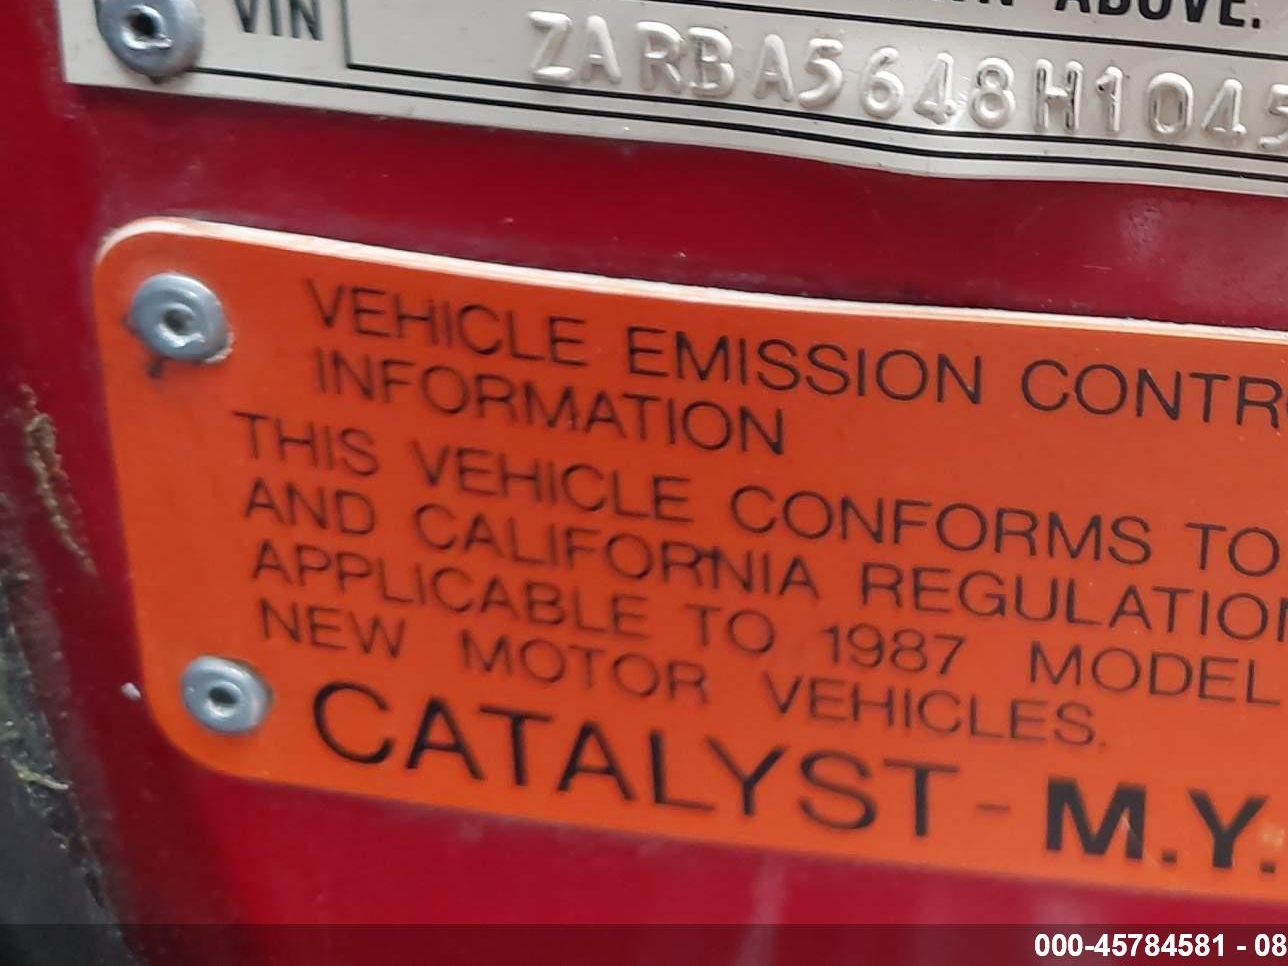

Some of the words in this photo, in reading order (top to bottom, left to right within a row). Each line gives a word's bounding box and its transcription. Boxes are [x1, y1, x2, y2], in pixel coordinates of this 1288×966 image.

[305, 279, 589, 369] VEHICLE
[626, 325, 983, 405] EMISSION
[312, 346, 785, 456] INFORMATION
[233, 411, 381, 477] THIS
[409, 440, 693, 524] VEHICLE
[730, 485, 1151, 565] CONFORMS
[1184, 521, 1280, 577] TO
[242, 478, 376, 538] AND
[414, 502, 819, 598] CALIFORNIA
[252, 540, 650, 640] APPLICABLE
[685, 603, 777, 657] TO
[822, 625, 965, 678] 1987
[1029, 641, 1281, 707] MODEL
[257, 598, 407, 661] NEW
[461, 630, 708, 705] MOTOR
[762, 670, 1106, 748] VEHICLES.
[312, 680, 958, 838] CATALYST
